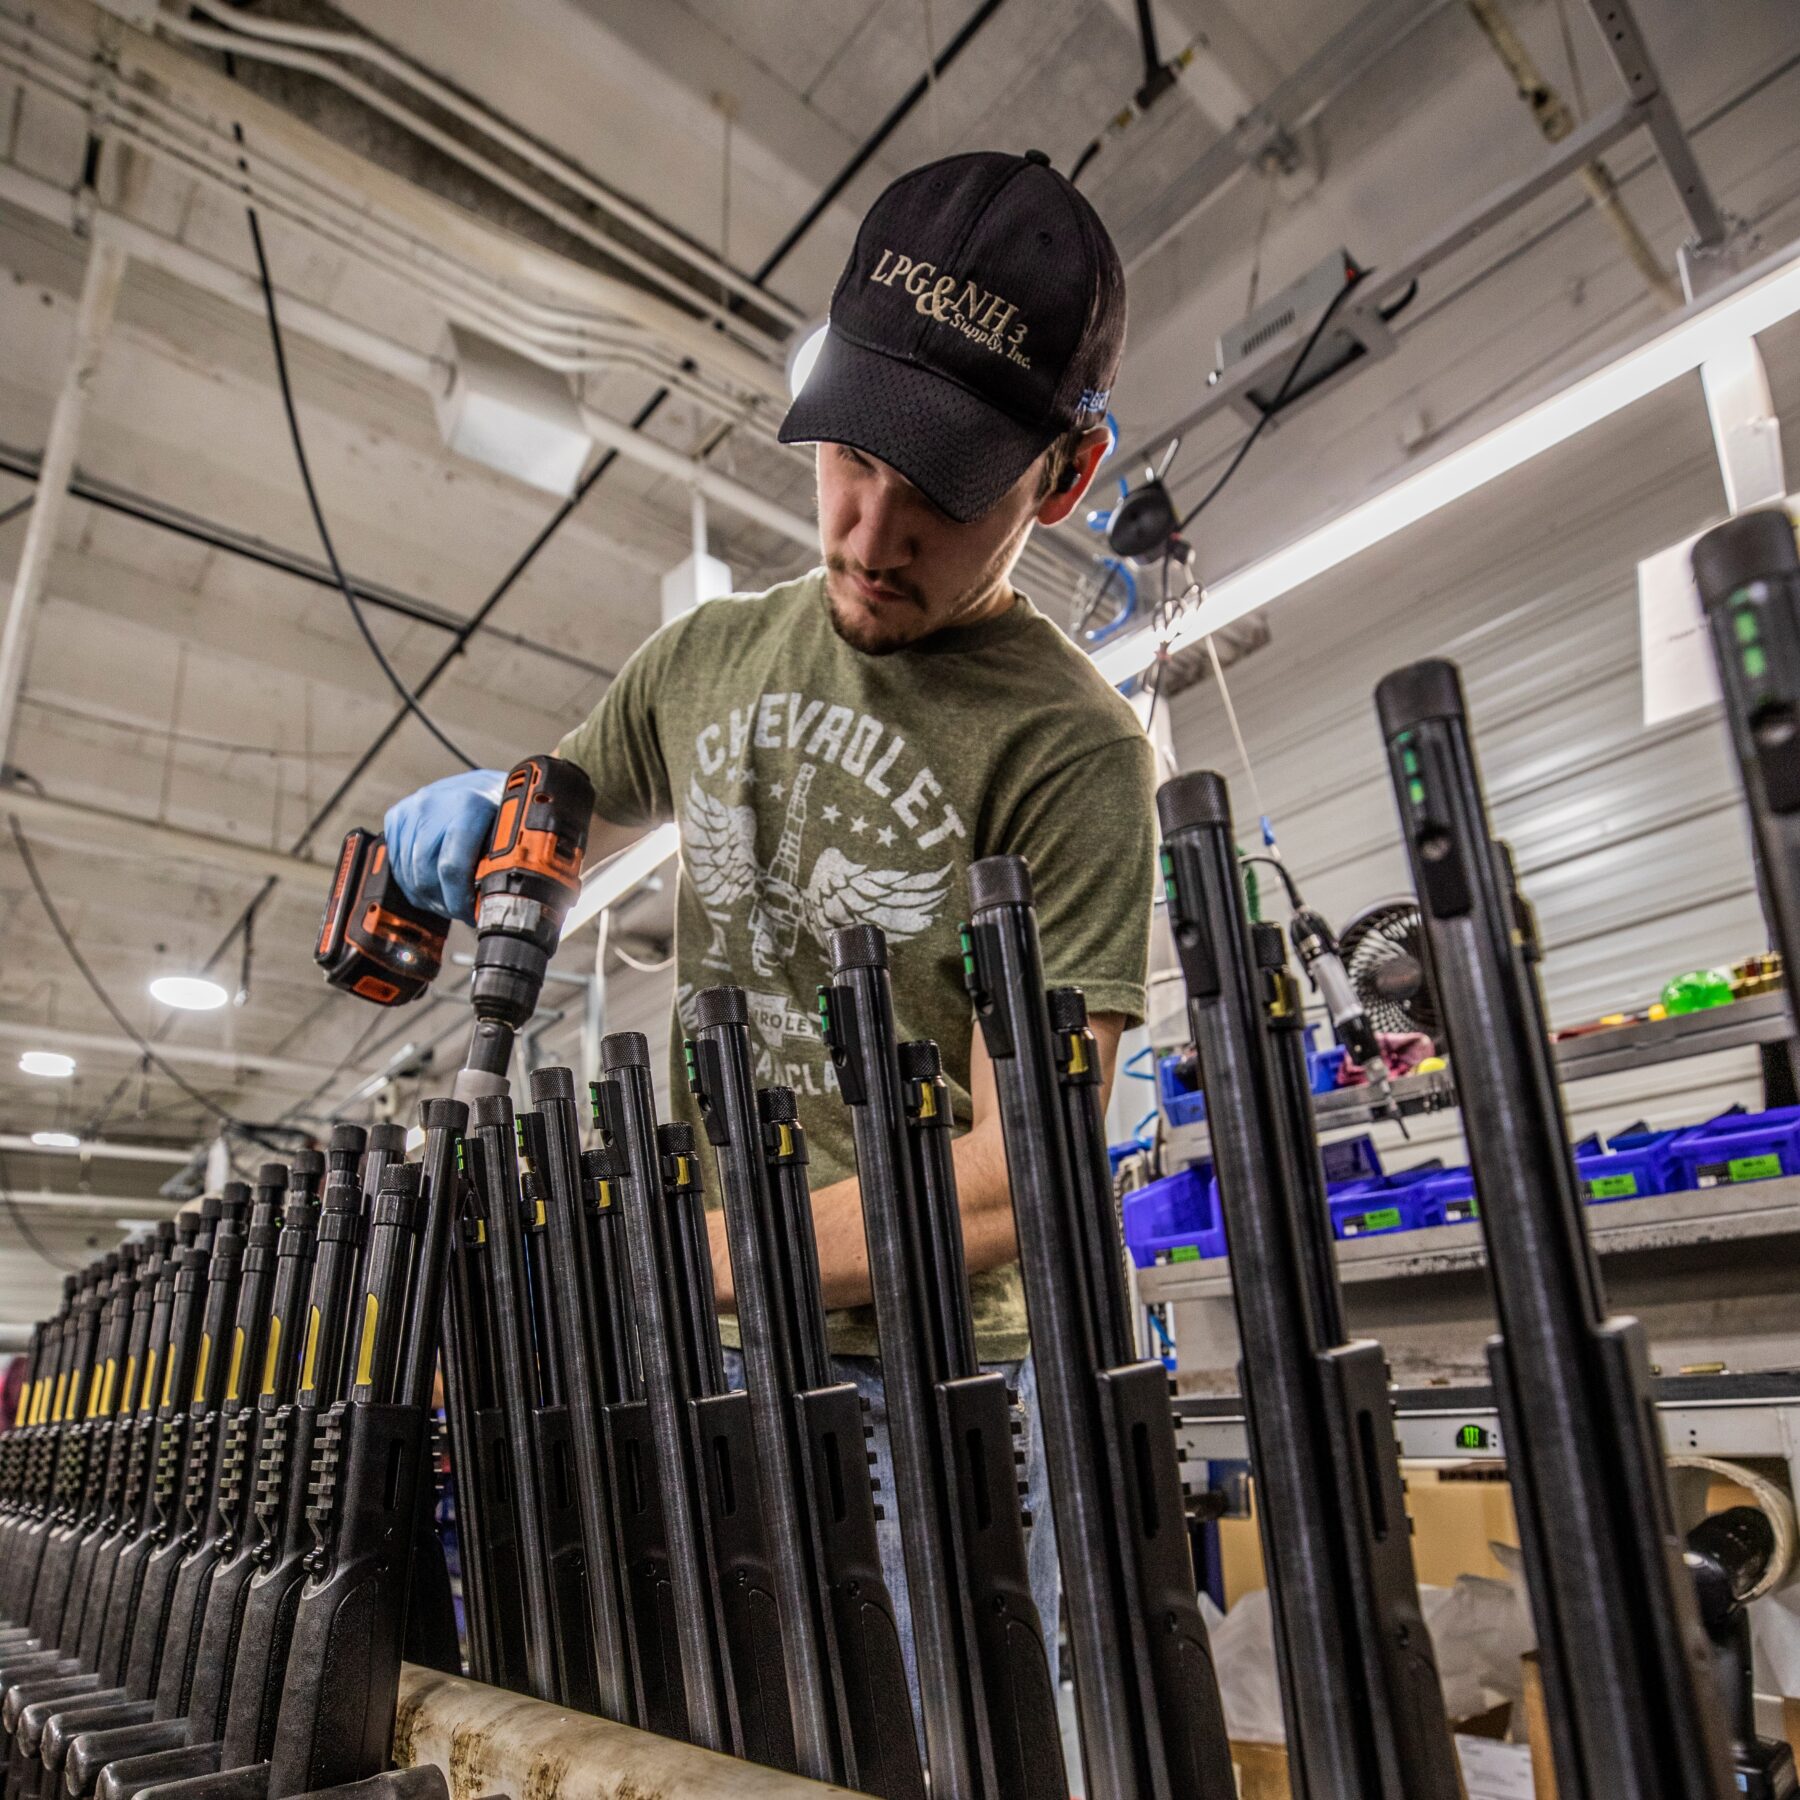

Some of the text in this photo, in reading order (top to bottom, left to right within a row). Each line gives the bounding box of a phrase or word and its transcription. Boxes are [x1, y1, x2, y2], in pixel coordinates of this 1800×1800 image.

[950, 312, 1031, 370] Supply, Inc.
[696, 692, 966, 850] CHEVROLET
